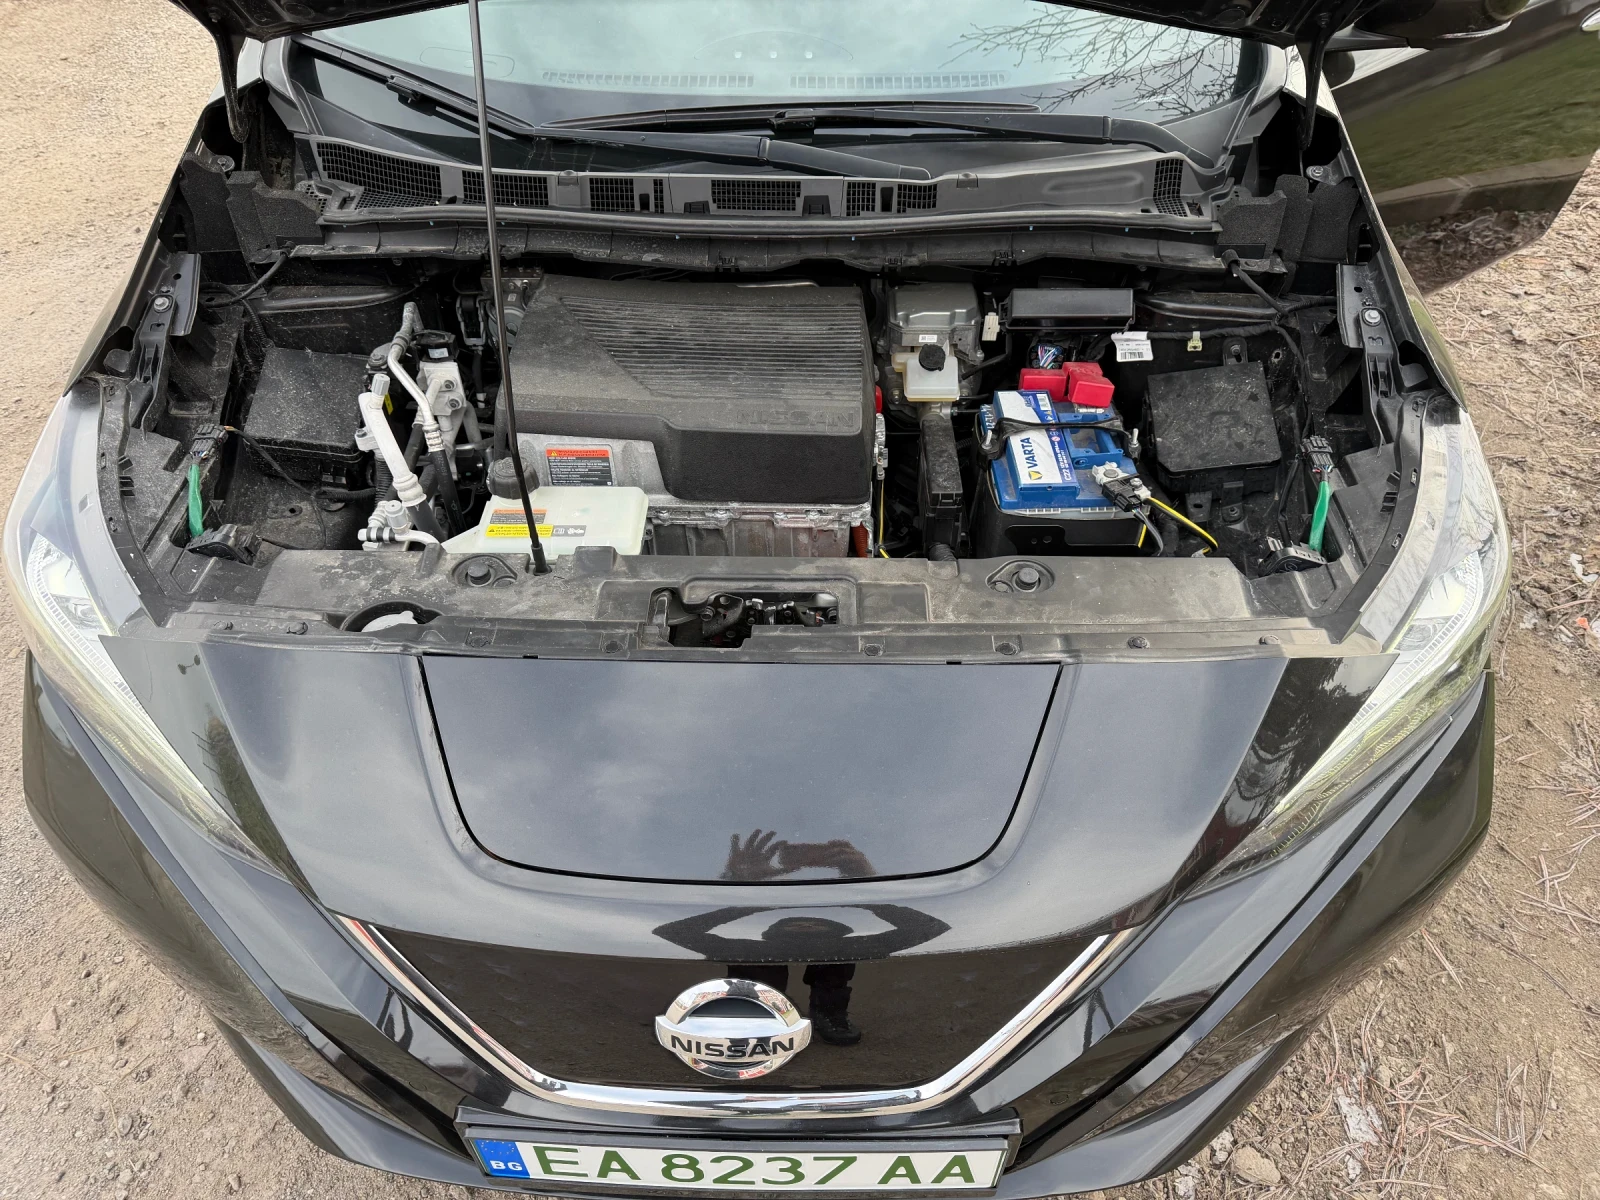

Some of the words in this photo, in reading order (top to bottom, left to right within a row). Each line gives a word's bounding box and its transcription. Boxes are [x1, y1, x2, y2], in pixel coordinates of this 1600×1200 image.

[736, 409, 854, 427] NISSAN
[1020, 437, 1039, 469] VARTA
[671, 1034, 794, 1058] NISSAN
[490, 1160, 523, 1171] BG
[532, 1145, 642, 1181] EA
[660, 1153, 858, 1186] 8237
[877, 1154, 975, 1185] AA
